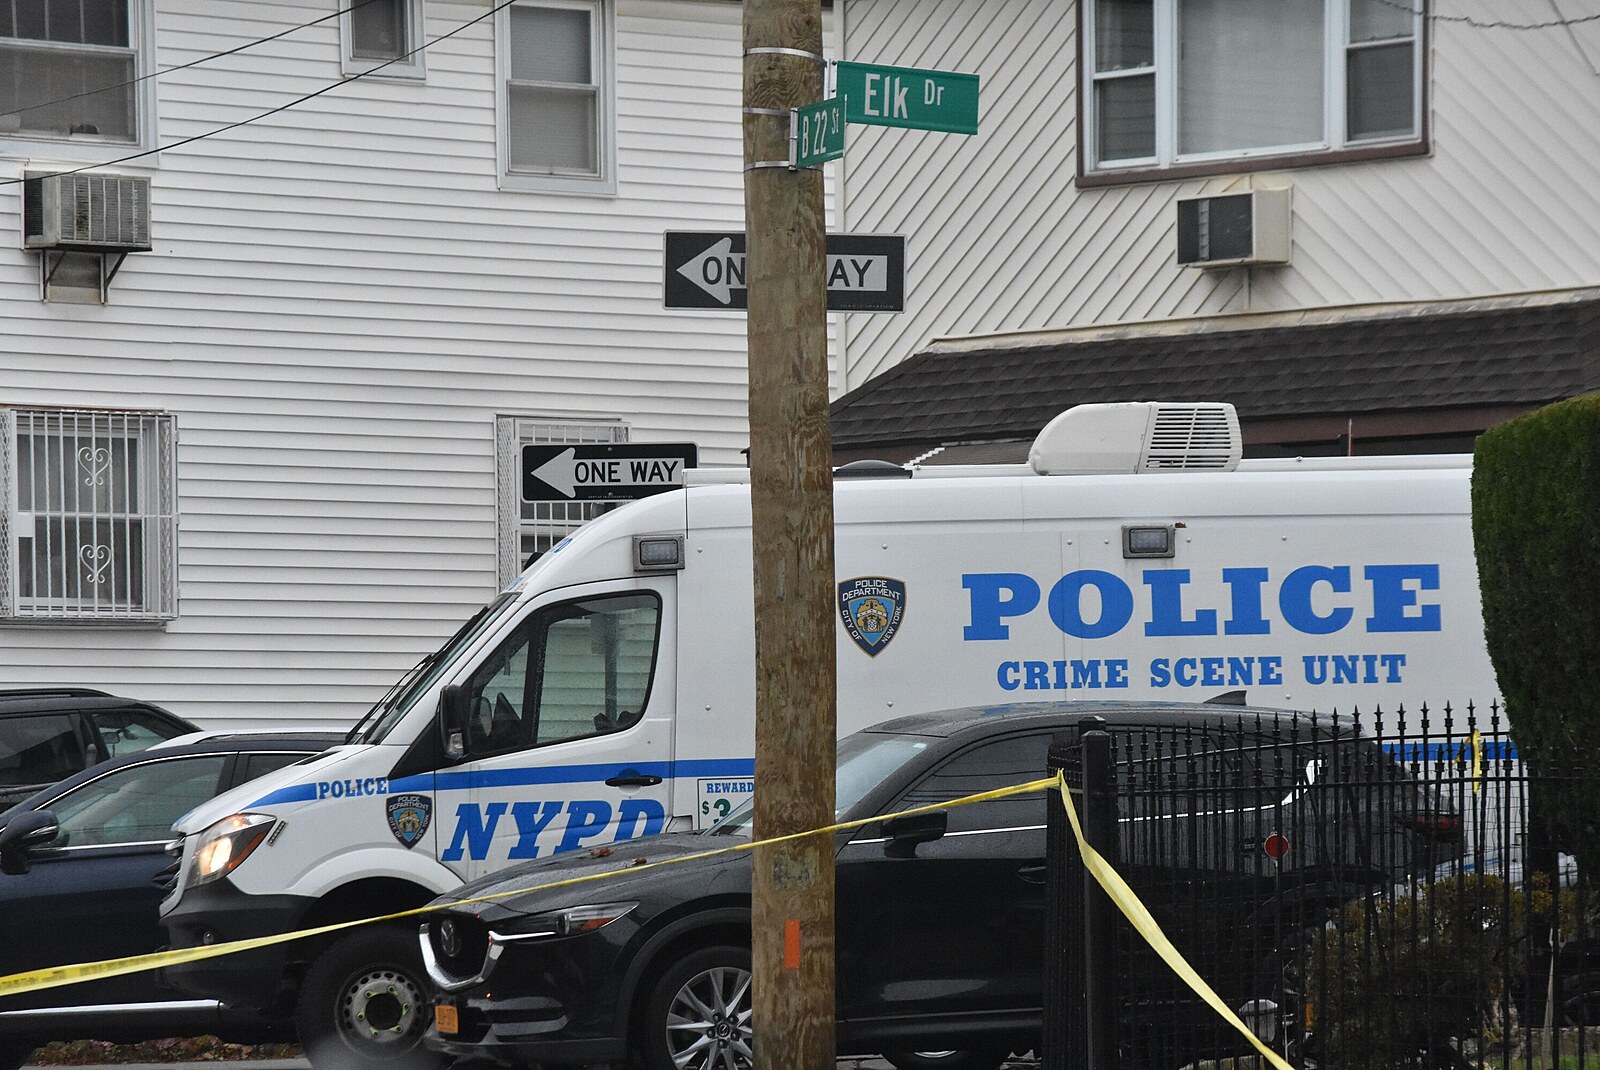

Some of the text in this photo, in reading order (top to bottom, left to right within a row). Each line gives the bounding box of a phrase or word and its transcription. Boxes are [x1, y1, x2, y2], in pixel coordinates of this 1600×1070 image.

[864, 73, 945, 119] Elk Dr
[802, 107, 839, 159] B 22 St
[702, 256, 874, 288] ON AY
[574, 460, 679, 483] ONE WAY
[842, 587, 901, 602] DEPARTMENT
[855, 579, 888, 589] POLICE
[962, 563, 1442, 641] POLICE
[842, 609, 863, 641] CITY OF
[881, 606, 902, 644] NEW YORK
[997, 654, 1407, 691] CRIME SCENE UNIT
[318, 776, 388, 800] POLICE
[706, 782, 755, 794] REWARD
[388, 801, 429, 812] DEPARTMENT
[441, 798, 666, 862] NYPD
